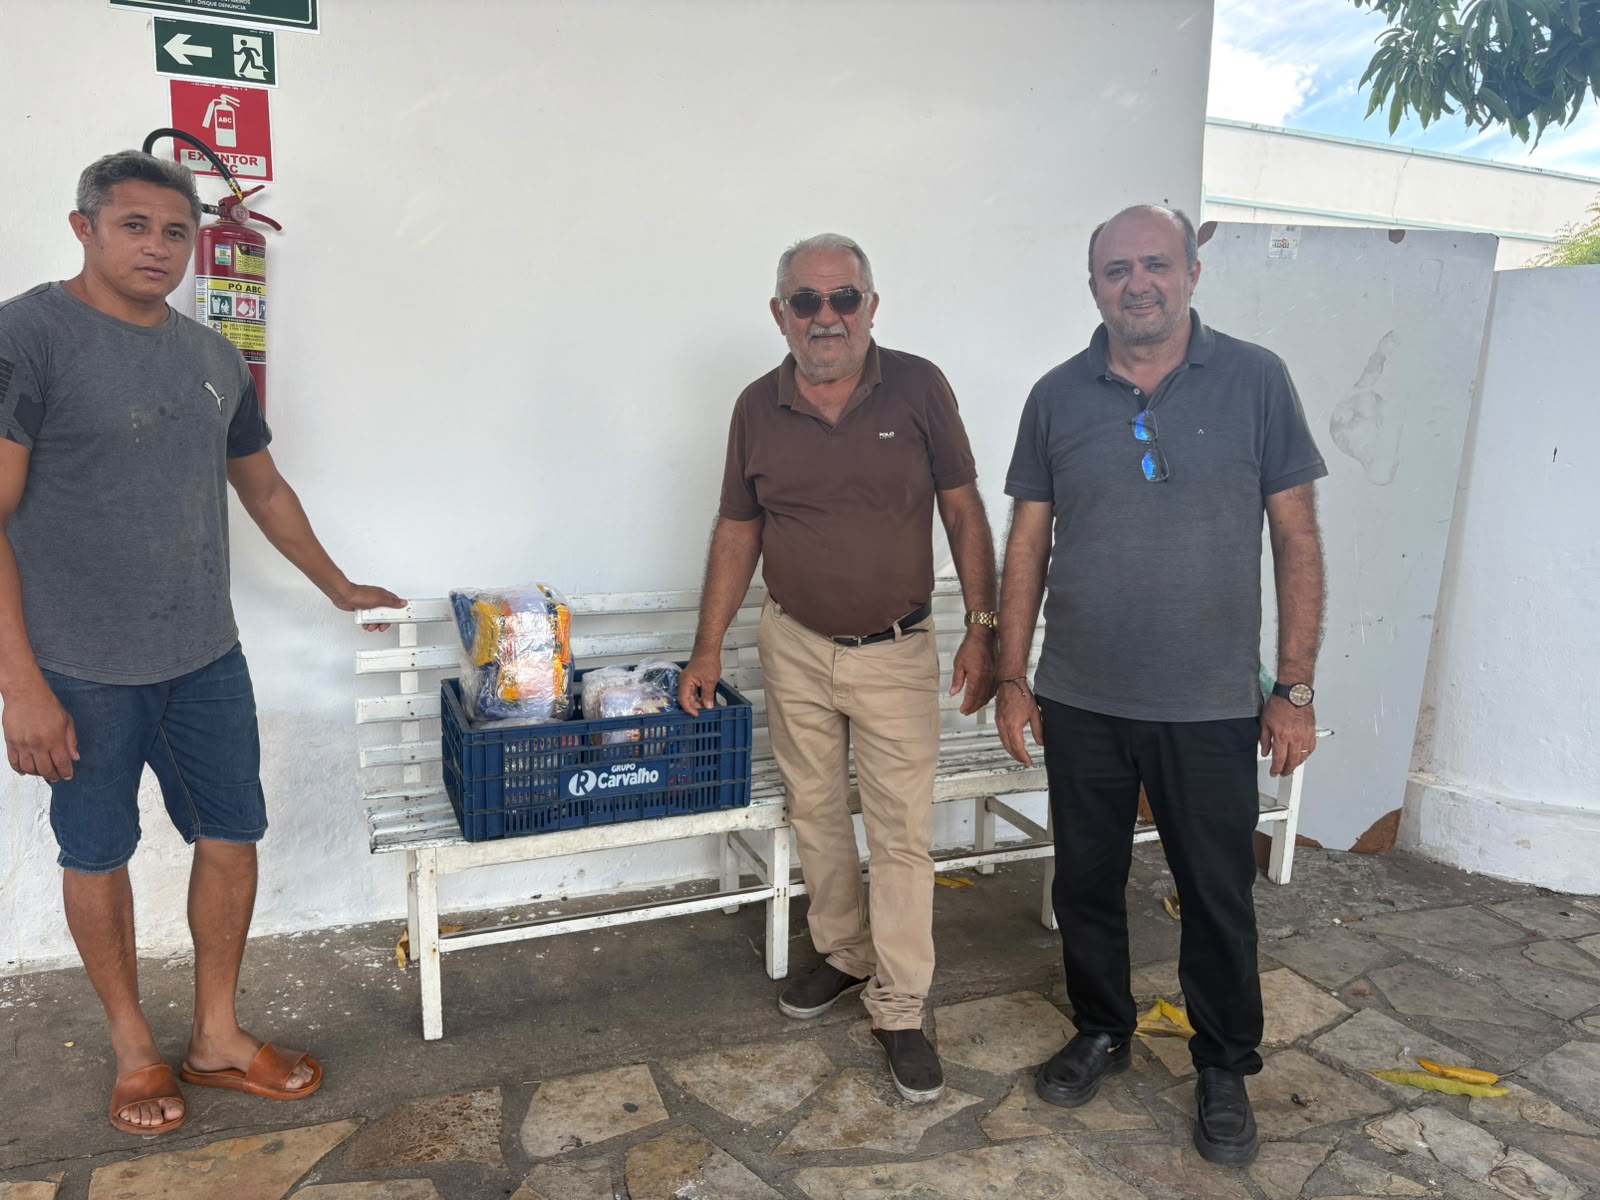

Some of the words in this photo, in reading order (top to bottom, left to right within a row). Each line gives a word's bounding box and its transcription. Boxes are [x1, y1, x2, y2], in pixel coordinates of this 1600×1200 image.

[228, 282, 242, 291] PÓ
[245, 285, 262, 294] ABC
[611, 763, 636, 773] GRUPO
[597, 767, 659, 789] Carvalho
